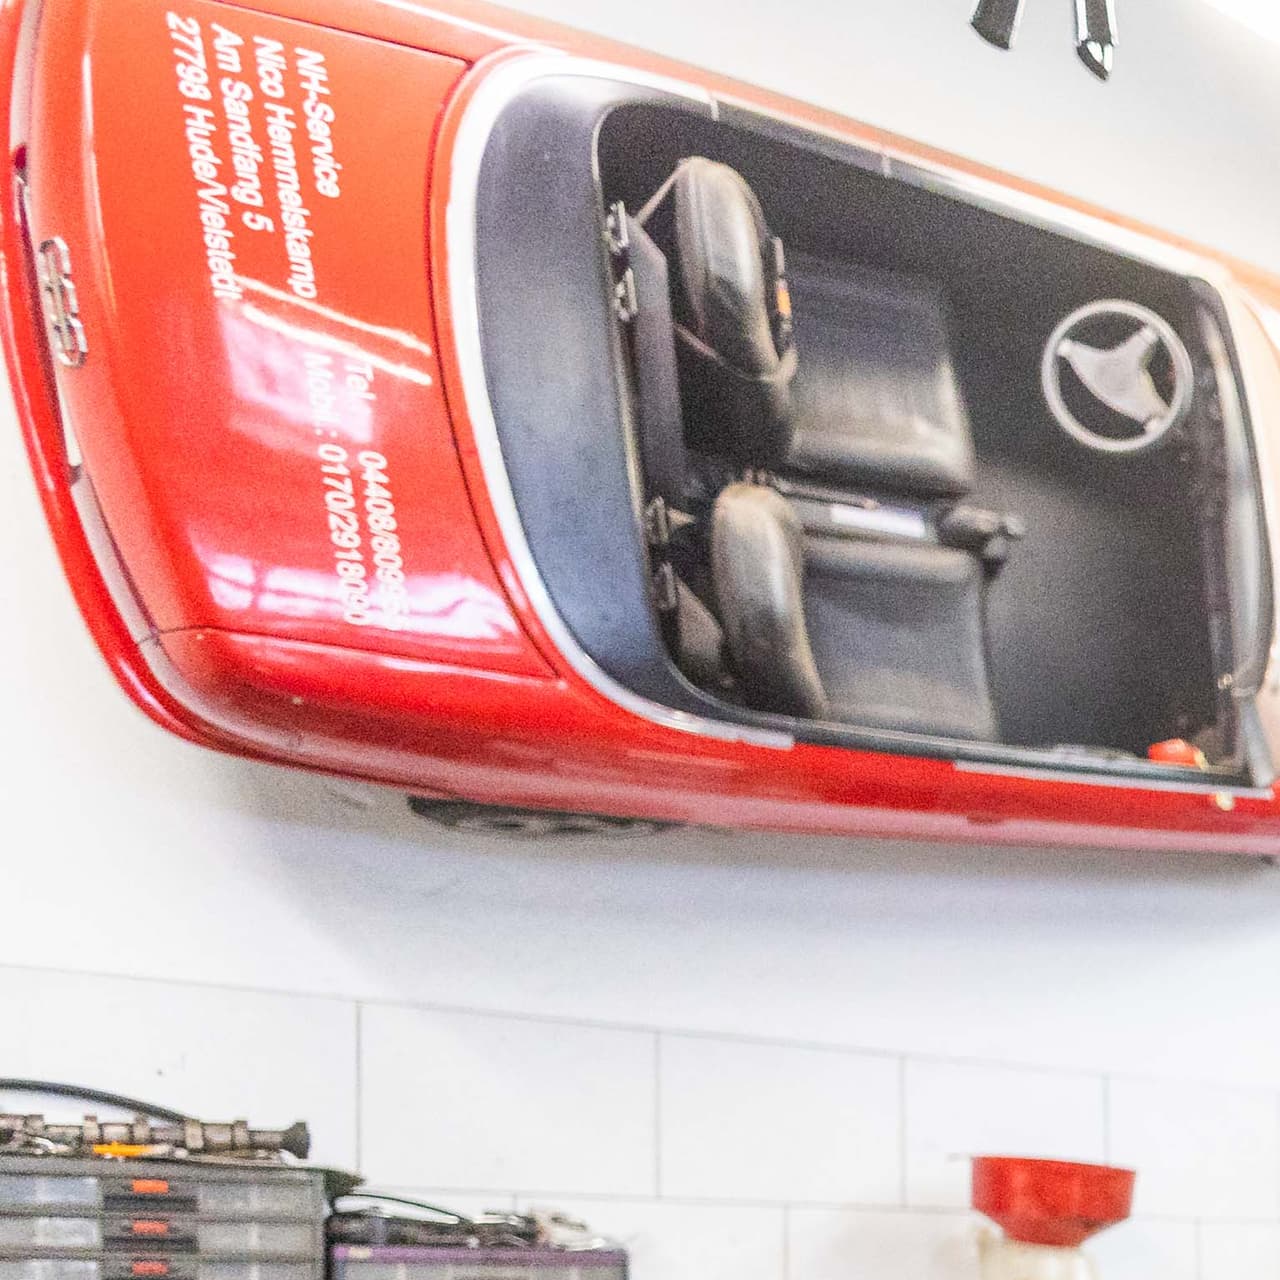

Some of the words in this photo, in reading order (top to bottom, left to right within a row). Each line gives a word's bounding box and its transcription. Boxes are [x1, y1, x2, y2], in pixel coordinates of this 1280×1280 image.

[166, 11, 213, 101] 27798
[211, 22, 245, 73] Am
[253, 36, 286, 98] Nico
[220, 77, 266, 208] Sandfang
[294, 47, 342, 198] NH-Service
[184, 104, 243, 301] Hude/Vielstedt
[242, 211, 275, 233] 5
[263, 102, 318, 300] Hemmelskamp
[317, 442, 371, 626] 0170/2918090
